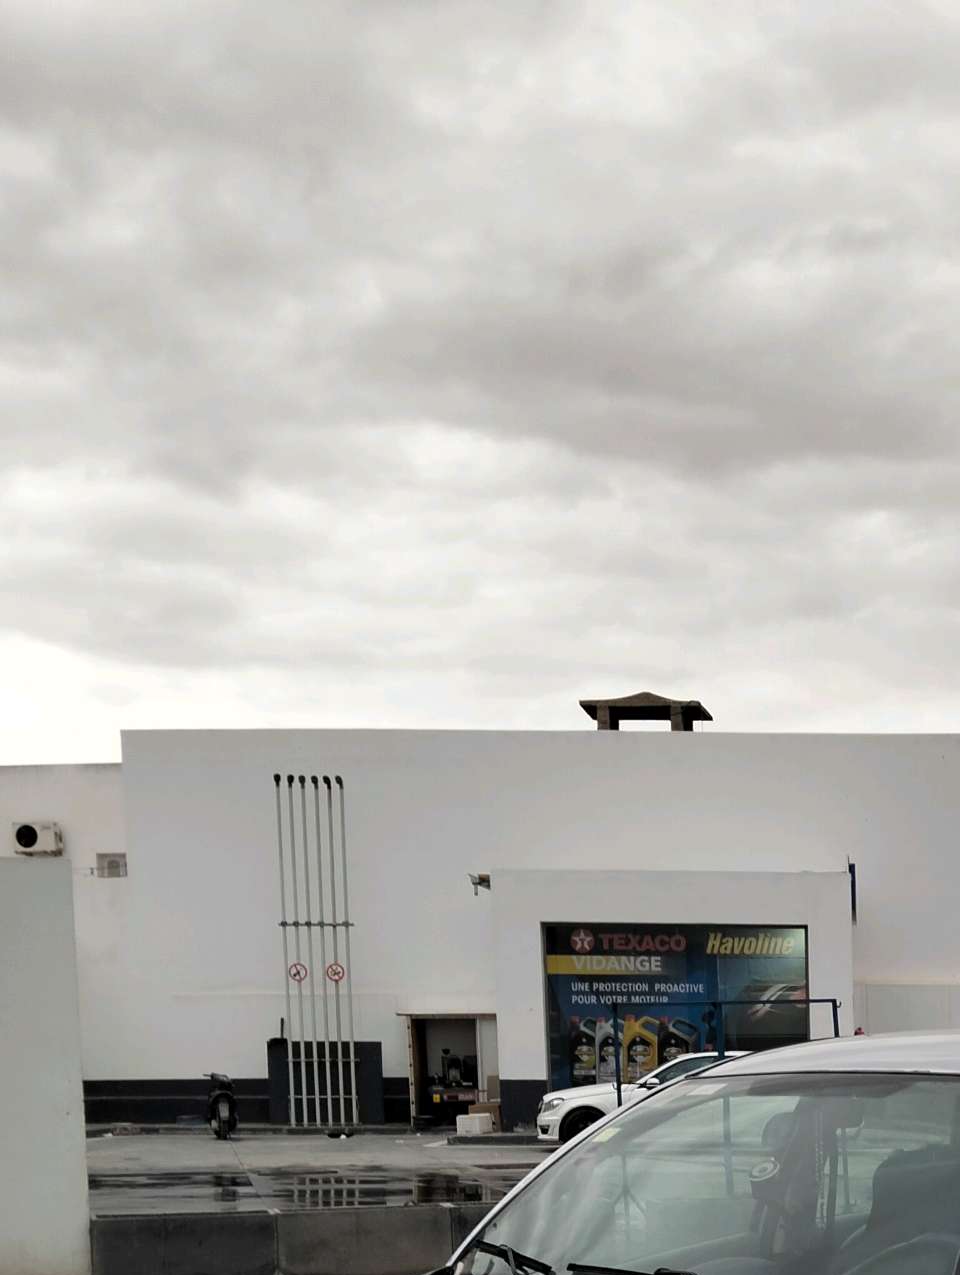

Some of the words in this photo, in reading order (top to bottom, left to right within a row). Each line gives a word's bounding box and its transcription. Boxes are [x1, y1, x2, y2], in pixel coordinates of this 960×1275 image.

[601, 934, 687, 951] TEXACO
[705, 931, 795, 956] Havoline
[572, 956, 662, 971] VIDANGE
[571, 982, 590, 992] UNE
[593, 982, 649, 993] PROTECTION
[654, 983, 705, 994] PROACTIVE
[571, 994, 598, 1005] POUR
[600, 994, 628, 1005] VOTRE
